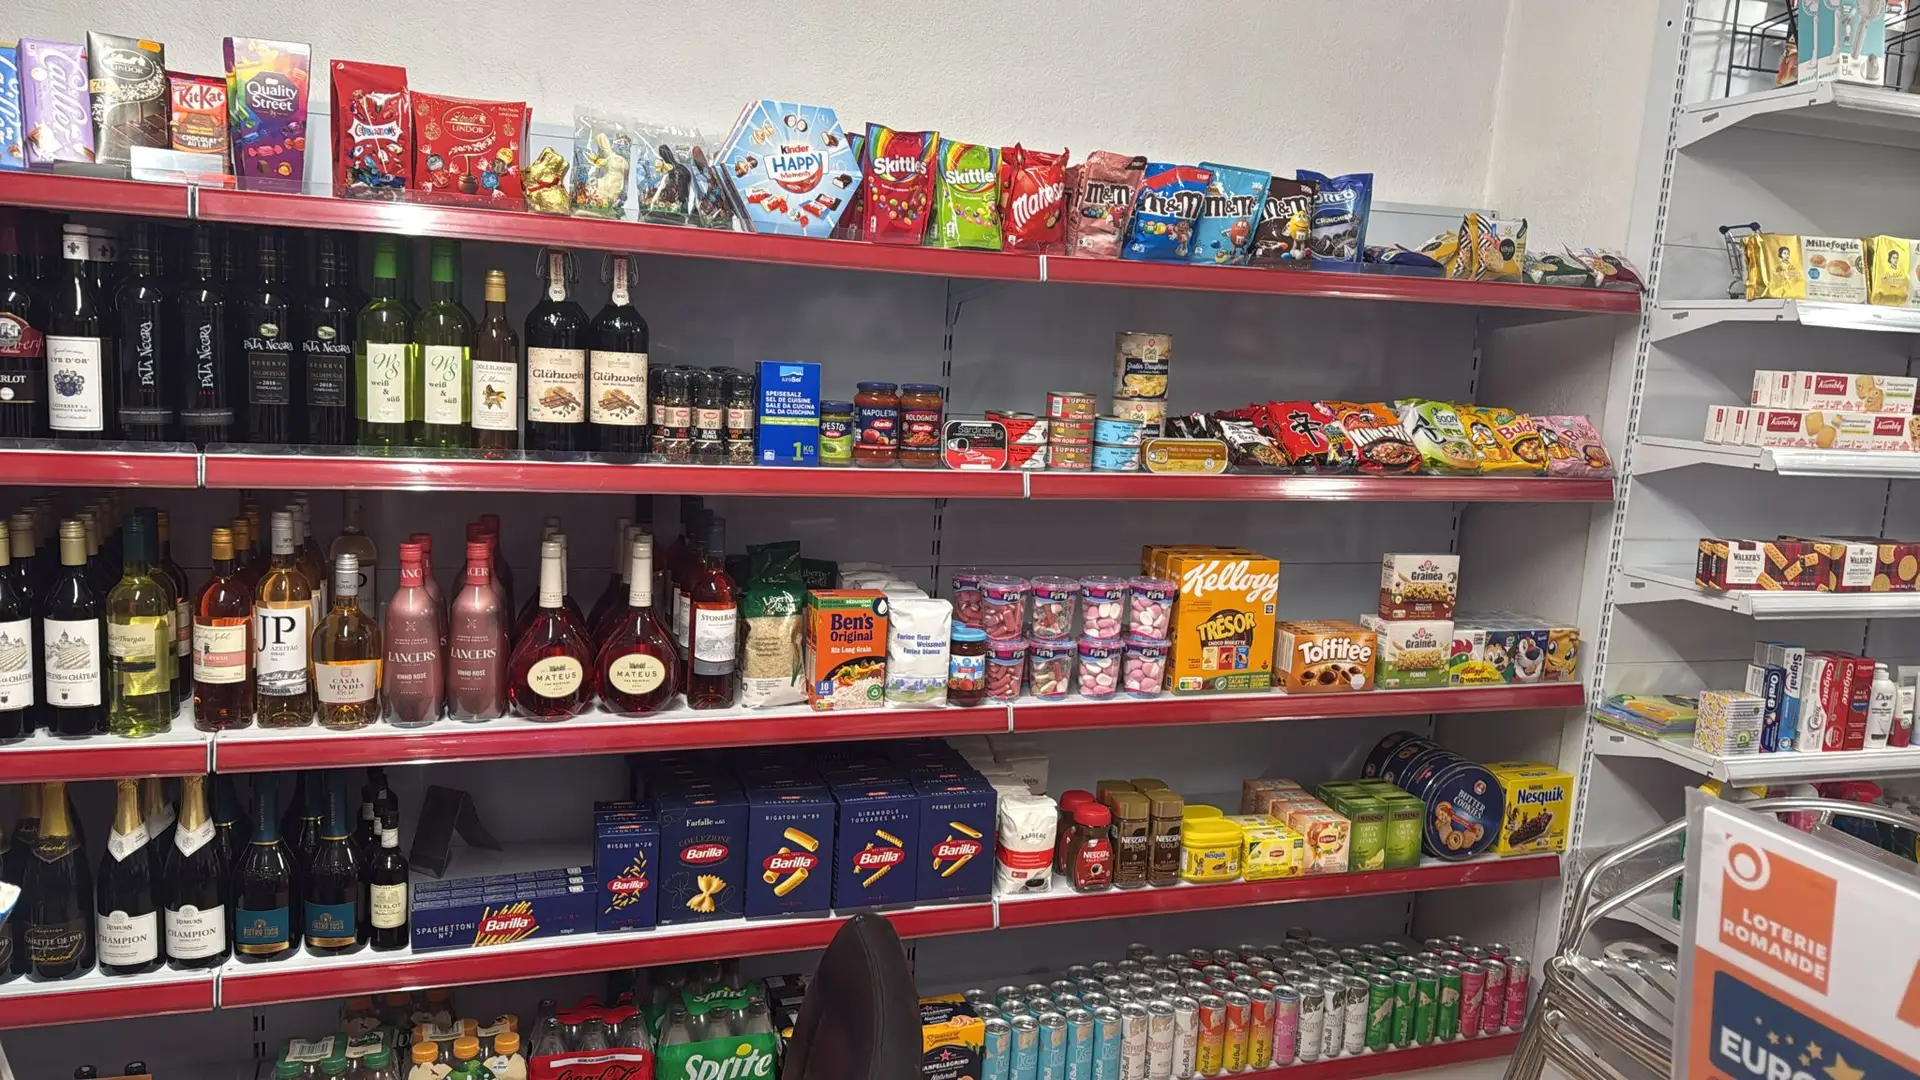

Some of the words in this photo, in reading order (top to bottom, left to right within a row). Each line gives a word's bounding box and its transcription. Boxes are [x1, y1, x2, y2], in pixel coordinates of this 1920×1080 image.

[178, 84, 224, 105] KitKat
[246, 82, 299, 102] Quality
[251, 95, 294, 112] Street
[452, 124, 484, 135] LINDOR
[771, 152, 823, 173] HAPPY
[873, 155, 928, 176] Skittles
[1805, 239, 1859, 251] Millefoglie
[532, 368, 584, 380] Glühwein
[593, 371, 645, 383] Glühwein
[1817, 380, 1846, 393] Kambly
[765, 390, 802, 398] SPEISESALZ
[765, 396, 778, 404] SEL
[787, 397, 812, 405] CUISINE
[765, 402, 779, 410] SALE
[780, 402, 790, 410] DA
[765, 408, 775, 416] SAL
[775, 408, 785, 416] DA
[786, 408, 815, 416] CUSCHINA
[905, 413, 939, 422] BOLOGNESE
[1770, 415, 1799, 428] Kambly
[1287, 409, 1323, 448] 辛
[1876, 420, 1902, 432] Kambly
[792, 441, 804, 462] 1
[1411, 571, 1444, 581] Grainéa
[830, 613, 874, 631] Ben's
[1197, 612, 1256, 641] TRÉSOR
[258, 614, 297, 652] JP
[830, 630, 873, 644] Original
[897, 633, 916, 641] Farine
[1405, 638, 1437, 649] Grainéa
[388, 649, 436, 664] LANCERS
[450, 647, 497, 660] LANCERS
[903, 647, 921, 655] Farina
[1298, 637, 1372, 664] Toffifee
[536, 671, 577, 682] MATEUS
[616, 670, 658, 678] MATEUS
[1790, 652, 1803, 690] Signal
[820, 682, 829, 691] 10
[1821, 661, 1835, 706] Colgate
[1841, 662, 1855, 706] Colgate
[1766, 673, 1780, 710] Oral-B
[1457, 789, 1486, 812] BUTTER
[1517, 786, 1564, 806] Nesquik
[858, 808, 900, 817] GIRANDOLE
[1453, 796, 1485, 821] COOKIES
[686, 817, 714, 827] Farfalle
[851, 815, 888, 824] TORSADES
[686, 848, 725, 860] Barilla
[938, 844, 979, 857] Barilla
[770, 856, 814, 869] Barilla
[860, 851, 901, 865] Barilla
[612, 880, 645, 892] Barilla
[416, 922, 476, 935] SPAGHETTONI
[485, 917, 531, 932] Barilla
[1741, 907, 1829, 962] LOTERIE
[1722, 917, 1827, 982] ROMANDE
[681, 1043, 773, 1080] Sprite
